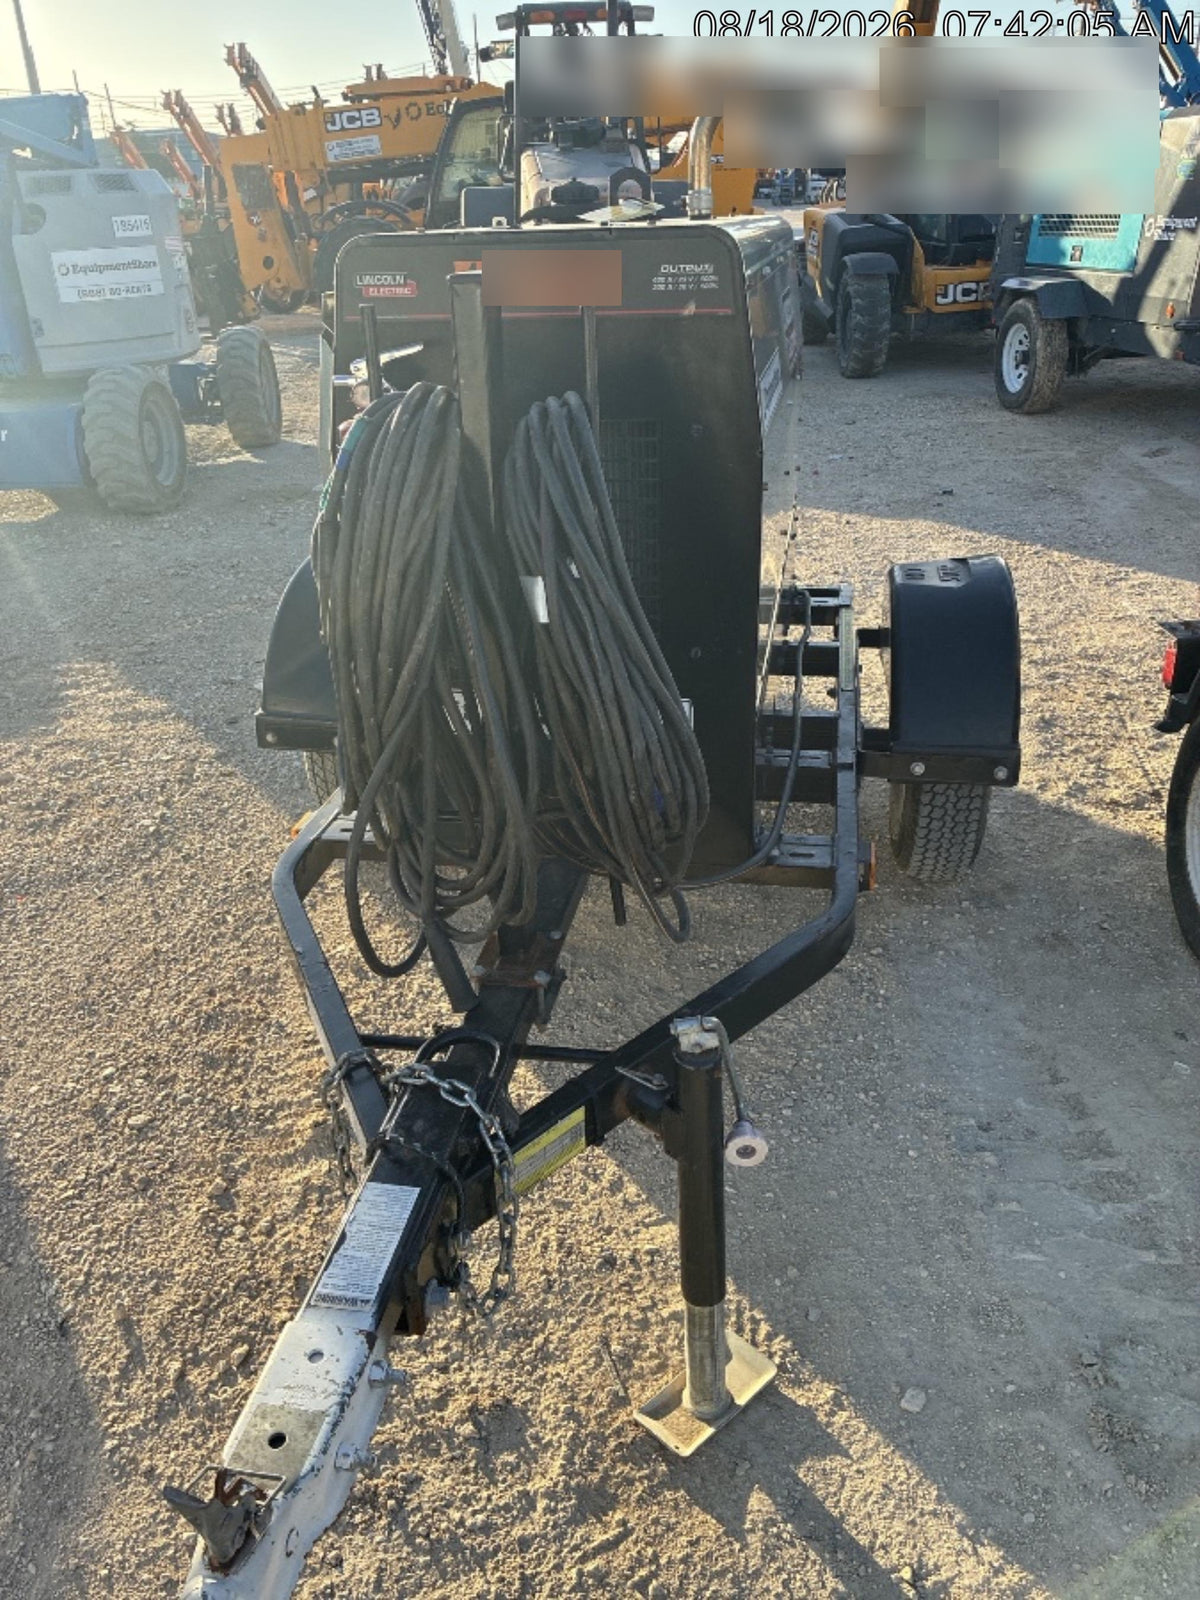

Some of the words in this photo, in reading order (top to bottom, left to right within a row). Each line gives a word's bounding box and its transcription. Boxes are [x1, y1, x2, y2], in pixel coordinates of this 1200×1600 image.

[325, 108, 381, 131] JCB
[356, 275, 405, 285] LINCOLN
[369, 287, 412, 296] ELECTRIC
